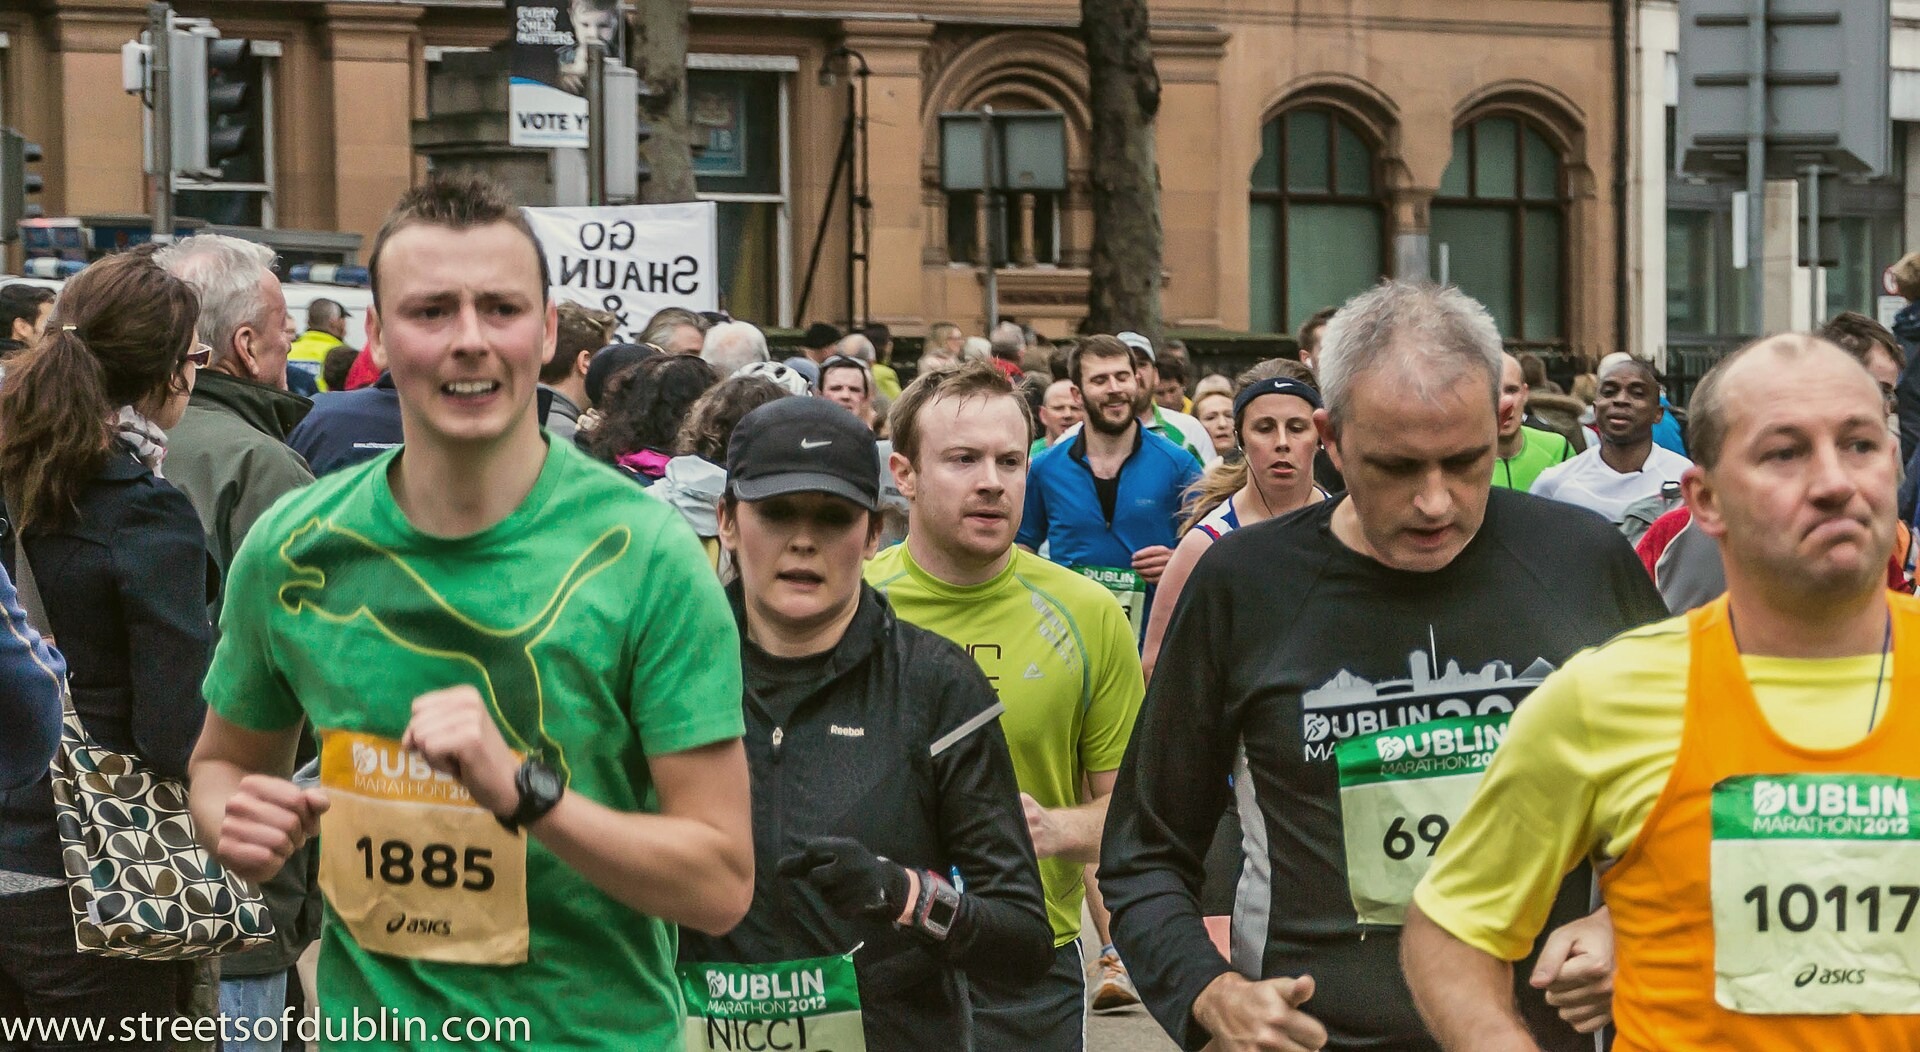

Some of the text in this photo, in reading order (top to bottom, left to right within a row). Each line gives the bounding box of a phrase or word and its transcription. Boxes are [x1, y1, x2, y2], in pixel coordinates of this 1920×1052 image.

[516, 112, 589, 130] VOTE Y
[1083, 567, 1135, 584] DUBLIN
[830, 724, 865, 737] Reebok
[1303, 703, 1432, 742] DUBLIN
[1376, 722, 1509, 763] DUBLIN
[352, 742, 453, 782] DUB
[1380, 752, 1496, 776] MARATHON 20
[354, 774, 471, 801] MARATHON 20
[1752, 780, 1909, 817] DUBLIN
[1383, 813, 1450, 861] 69
[1753, 816, 1910, 836] MARATHON 2012
[356, 835, 495, 892] 1885
[1744, 883, 1920, 932] 10117
[706, 968, 826, 1001] DUBLIN
[1819, 968, 1866, 985] asics
[706, 996, 826, 1016] MARATHON 2012
[707, 1014, 807, 1052] NICCI
